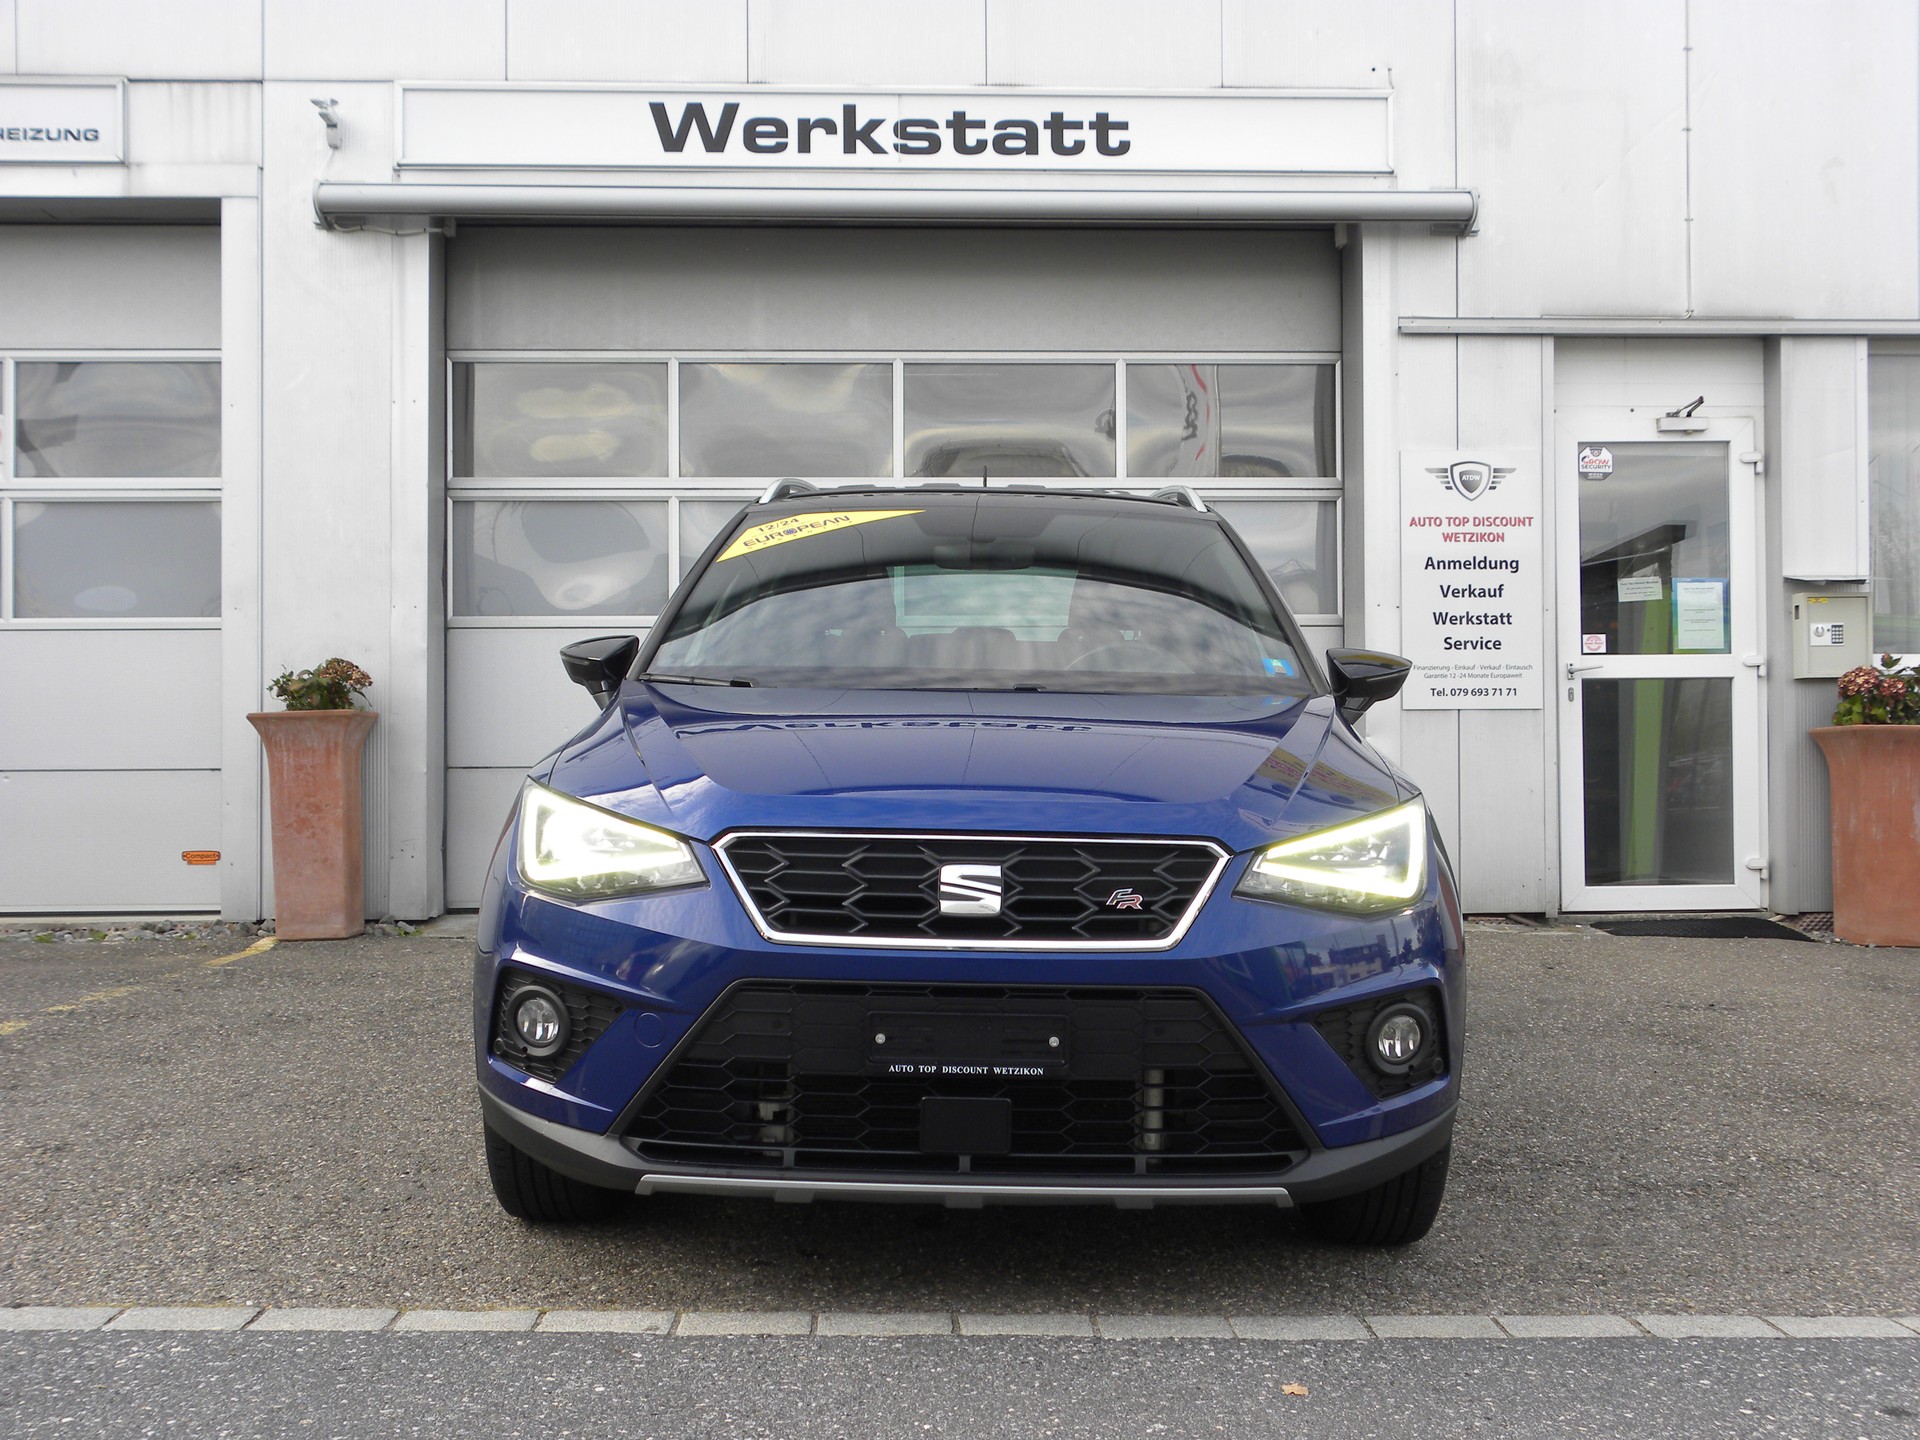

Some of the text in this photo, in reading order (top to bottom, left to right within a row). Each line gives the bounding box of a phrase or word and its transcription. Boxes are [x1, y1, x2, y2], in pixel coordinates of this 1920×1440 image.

[0, 127, 99, 141] EIZUNG
[648, 101, 1131, 157] Werkstatt
[758, 517, 800, 532] 12/24
[1409, 516, 1534, 527] AUTO TOP DISCOUNT
[743, 515, 851, 547] EUROPEAN
[1442, 532, 1505, 543] WETZIKON
[1424, 556, 1520, 574] Anmeldung
[1439, 583, 1505, 598] Verkauf
[1432, 611, 1513, 625] Werkstatt
[1443, 636, 1502, 650] Service
[1413, 664, 1451, 672] Finanzierung
[1490, 672, 1523, 680] Europaweit
[1430, 687, 1517, 697] Tel. 079 693 71 71
[1105, 887, 1143, 911] FR
[888, 1064, 1044, 1076] AUTO TOP DISCOUNT WETZIKON
